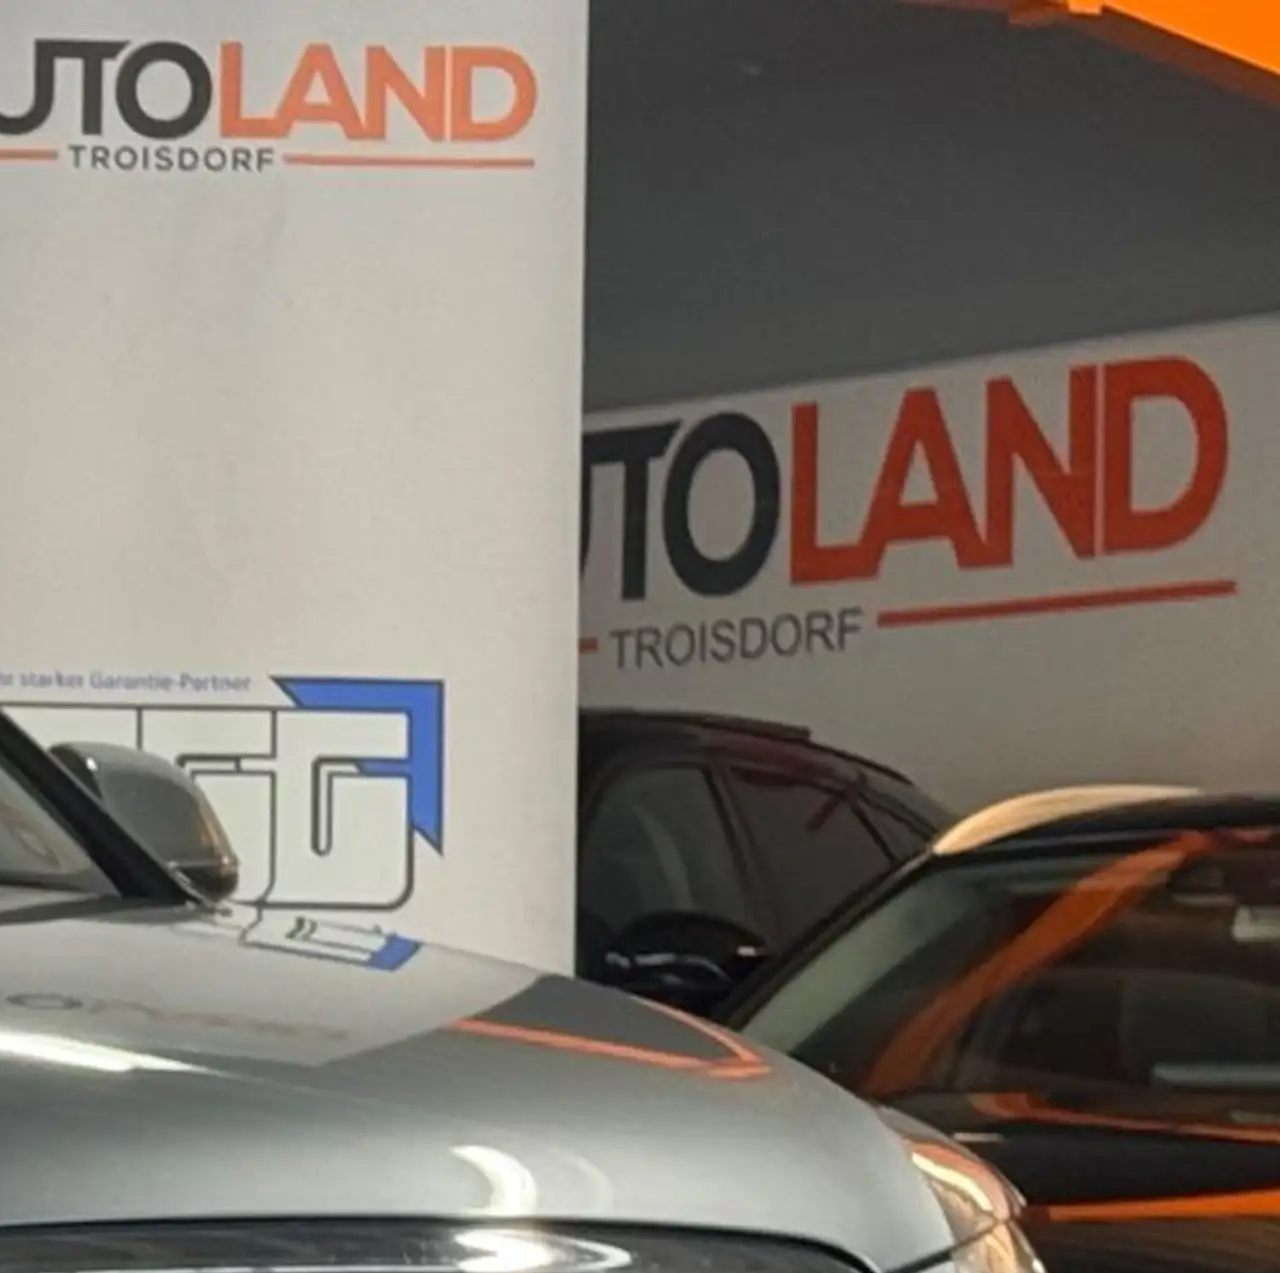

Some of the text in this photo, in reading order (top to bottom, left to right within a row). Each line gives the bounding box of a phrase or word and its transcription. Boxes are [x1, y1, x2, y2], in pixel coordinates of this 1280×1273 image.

[68, 144, 276, 173] TROISDORF
[581, 355, 1230, 601] TOLAND
[608, 607, 863, 670] TROISDORF
